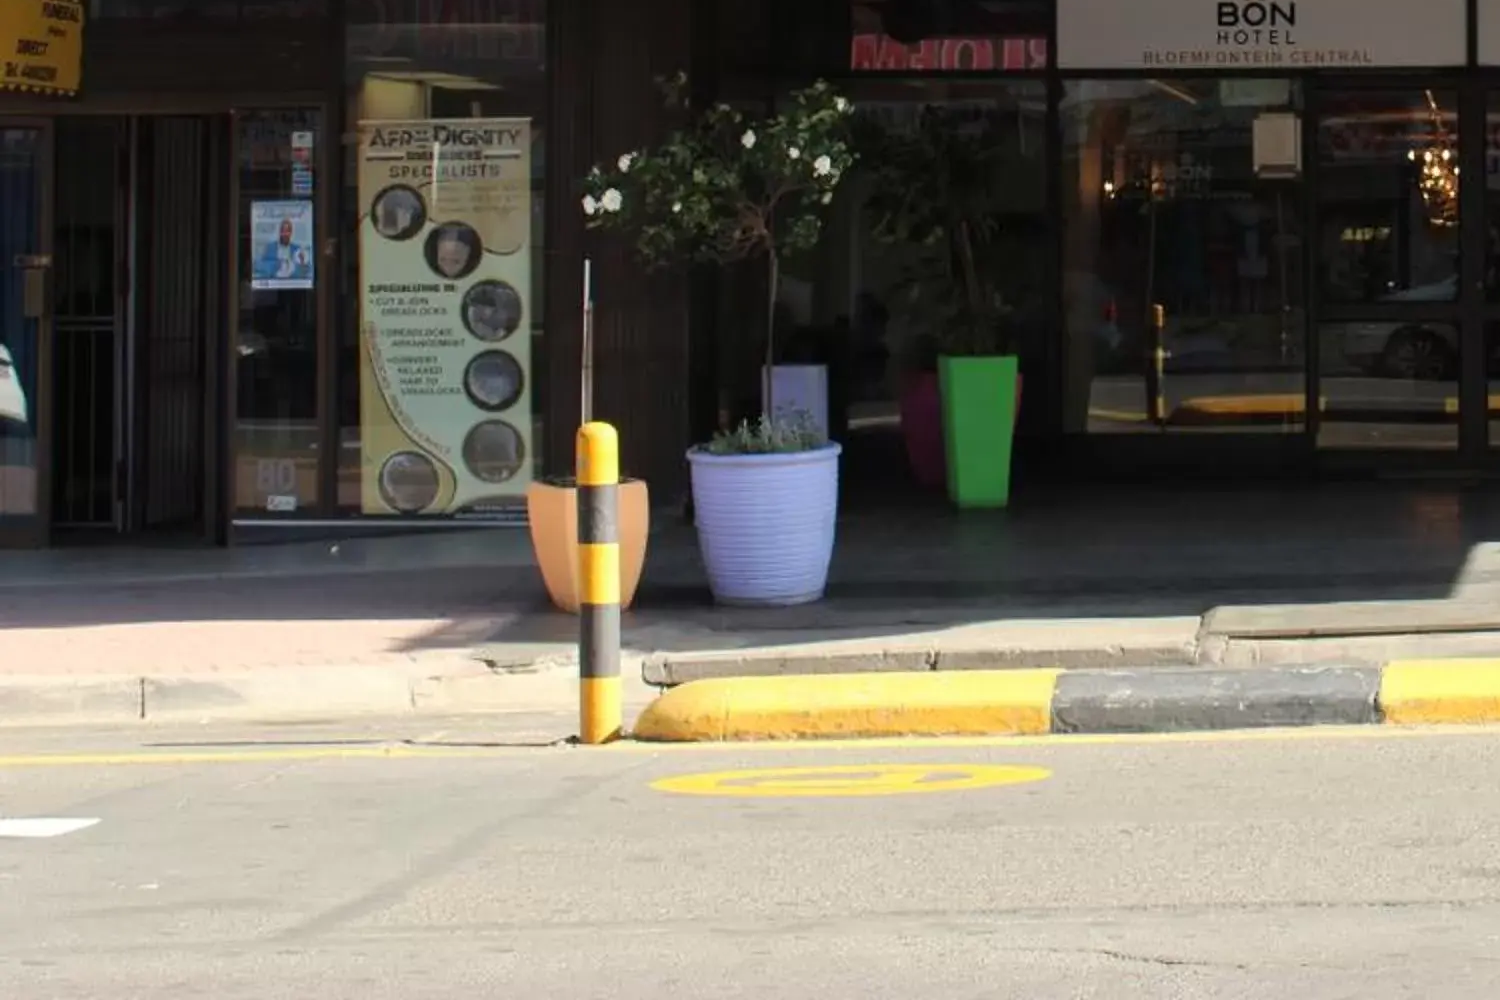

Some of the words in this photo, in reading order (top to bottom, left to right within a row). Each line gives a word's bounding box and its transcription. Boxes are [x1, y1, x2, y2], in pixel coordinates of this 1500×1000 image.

[1217, 1, 1297, 27] BON
[1216, 29, 1297, 45] HOTEL
[1142, 51, 1283, 65] BLOEMFONTEIN
[1289, 50, 1374, 64] CENTRAL
[389, 164, 501, 179] SPECALISTS
